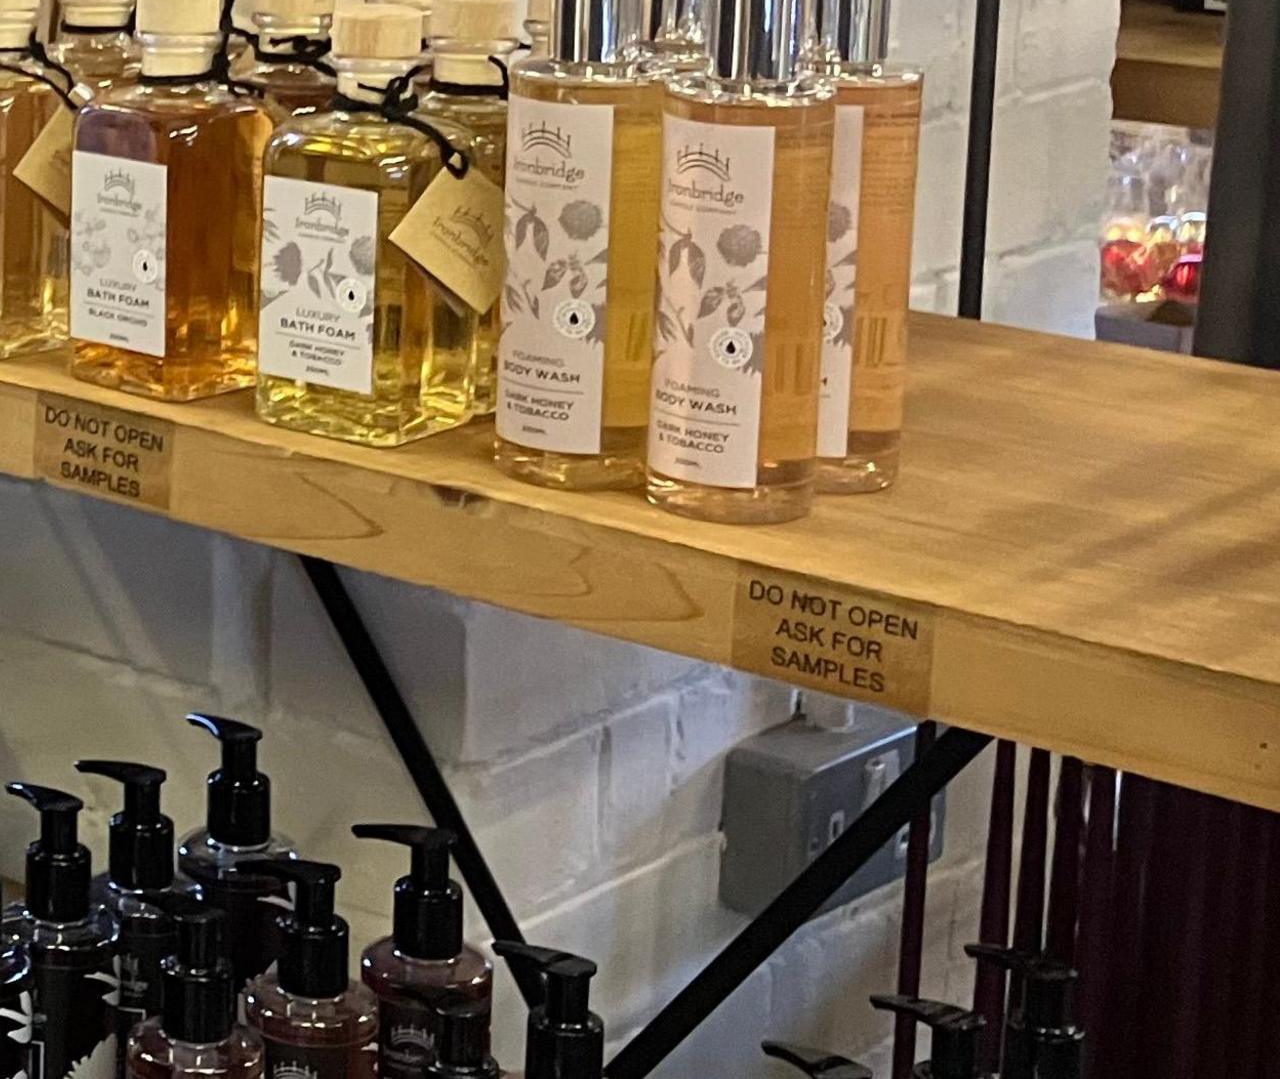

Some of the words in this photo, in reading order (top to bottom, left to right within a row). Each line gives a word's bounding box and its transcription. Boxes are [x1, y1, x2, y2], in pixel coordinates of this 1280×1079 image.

[668, 178, 744, 208] Ironbridge
[99, 278, 137, 292] LUXURY
[87, 288, 116, 303] BATH
[118, 294, 150, 308] FOAM
[296, 307, 341, 322] LUXURY
[280, 317, 315, 333] BATH
[317, 324, 356, 340] FOAM
[504, 360, 533, 376] BODY
[535, 369, 580, 384] WASH
[665, 379, 721, 398] FOAMING
[514, 403, 569, 421] TOBACCO
[531, 397, 574, 410] HONEY
[655, 388, 685, 405] BODY
[689, 398, 737, 415] WASH
[45, 406, 70, 427] DO
[75, 414, 110, 437] NOT
[114, 425, 164, 452] OPEN
[685, 428, 729, 443] HONEY
[64, 438, 98, 460] ASK
[103, 447, 139, 472] FOR
[667, 434, 724, 454] TOBACCO
[61, 461, 140, 497] SAMPLES
[749, 580, 784, 605] DO
[791, 590, 842, 620] NOT
[848, 605, 918, 640] OPEN
[775, 619, 826, 647] ASK
[832, 631, 883, 662] FOR
[771, 646, 885, 693] SAMPLES
